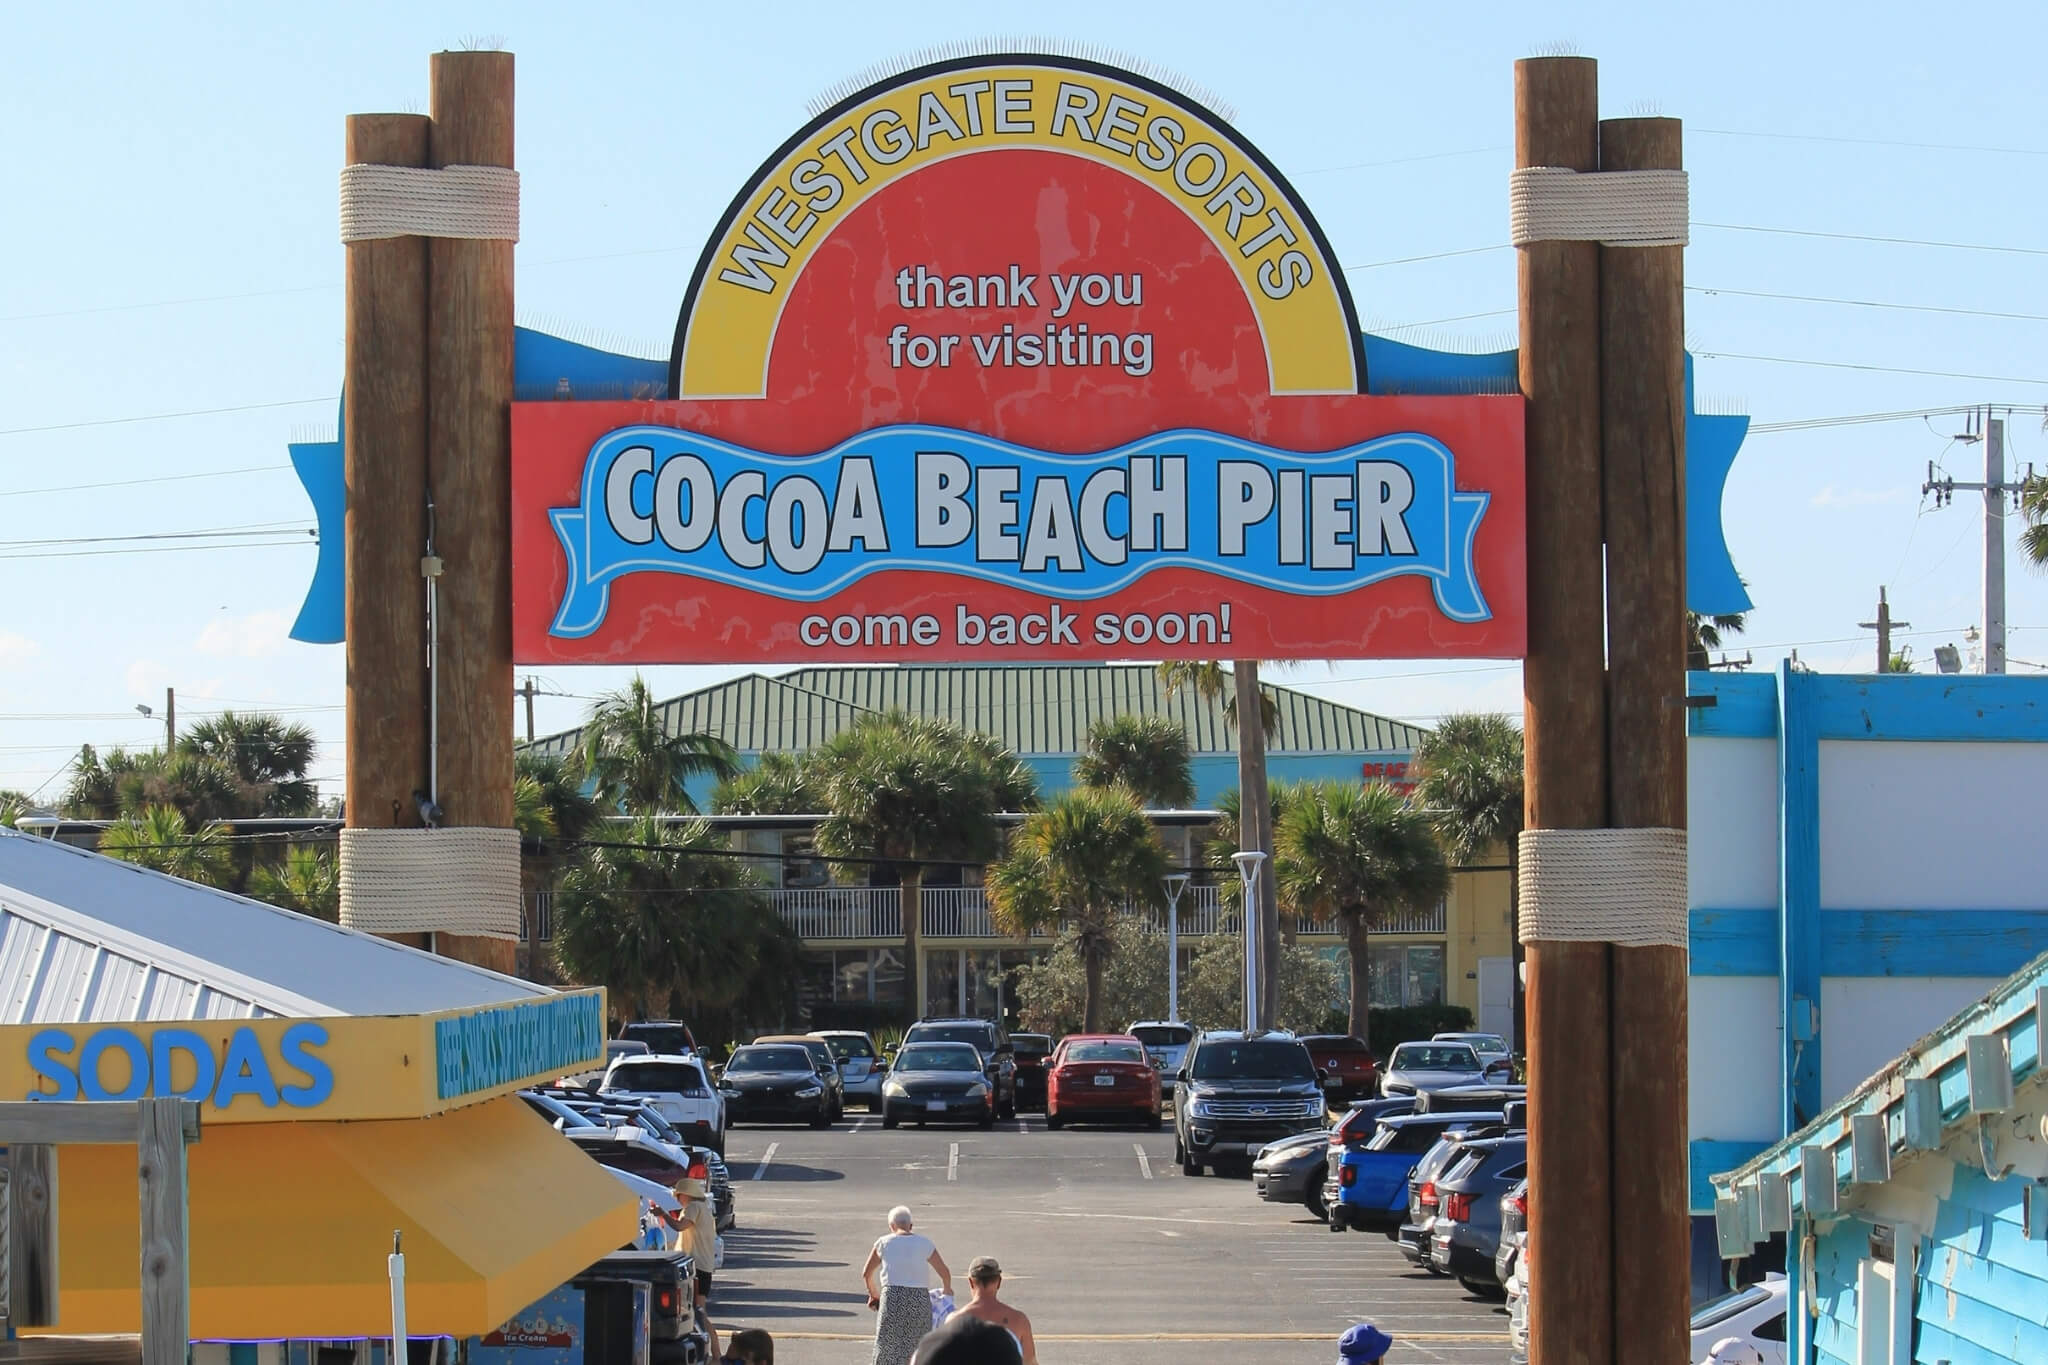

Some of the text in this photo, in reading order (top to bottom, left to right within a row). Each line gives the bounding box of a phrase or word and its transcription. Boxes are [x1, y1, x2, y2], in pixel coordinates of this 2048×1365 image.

[719, 79, 1313, 300] WESTGATE RESORTS
[896, 264, 1143, 318] thank you
[888, 323, 1154, 377] for visiting
[604, 446, 1418, 574] COCOA BEACH PIER
[799, 602, 1233, 647] come back soon!
[26, 1022, 335, 1108] SODAS
[519, 1334, 548, 1342] Cream
